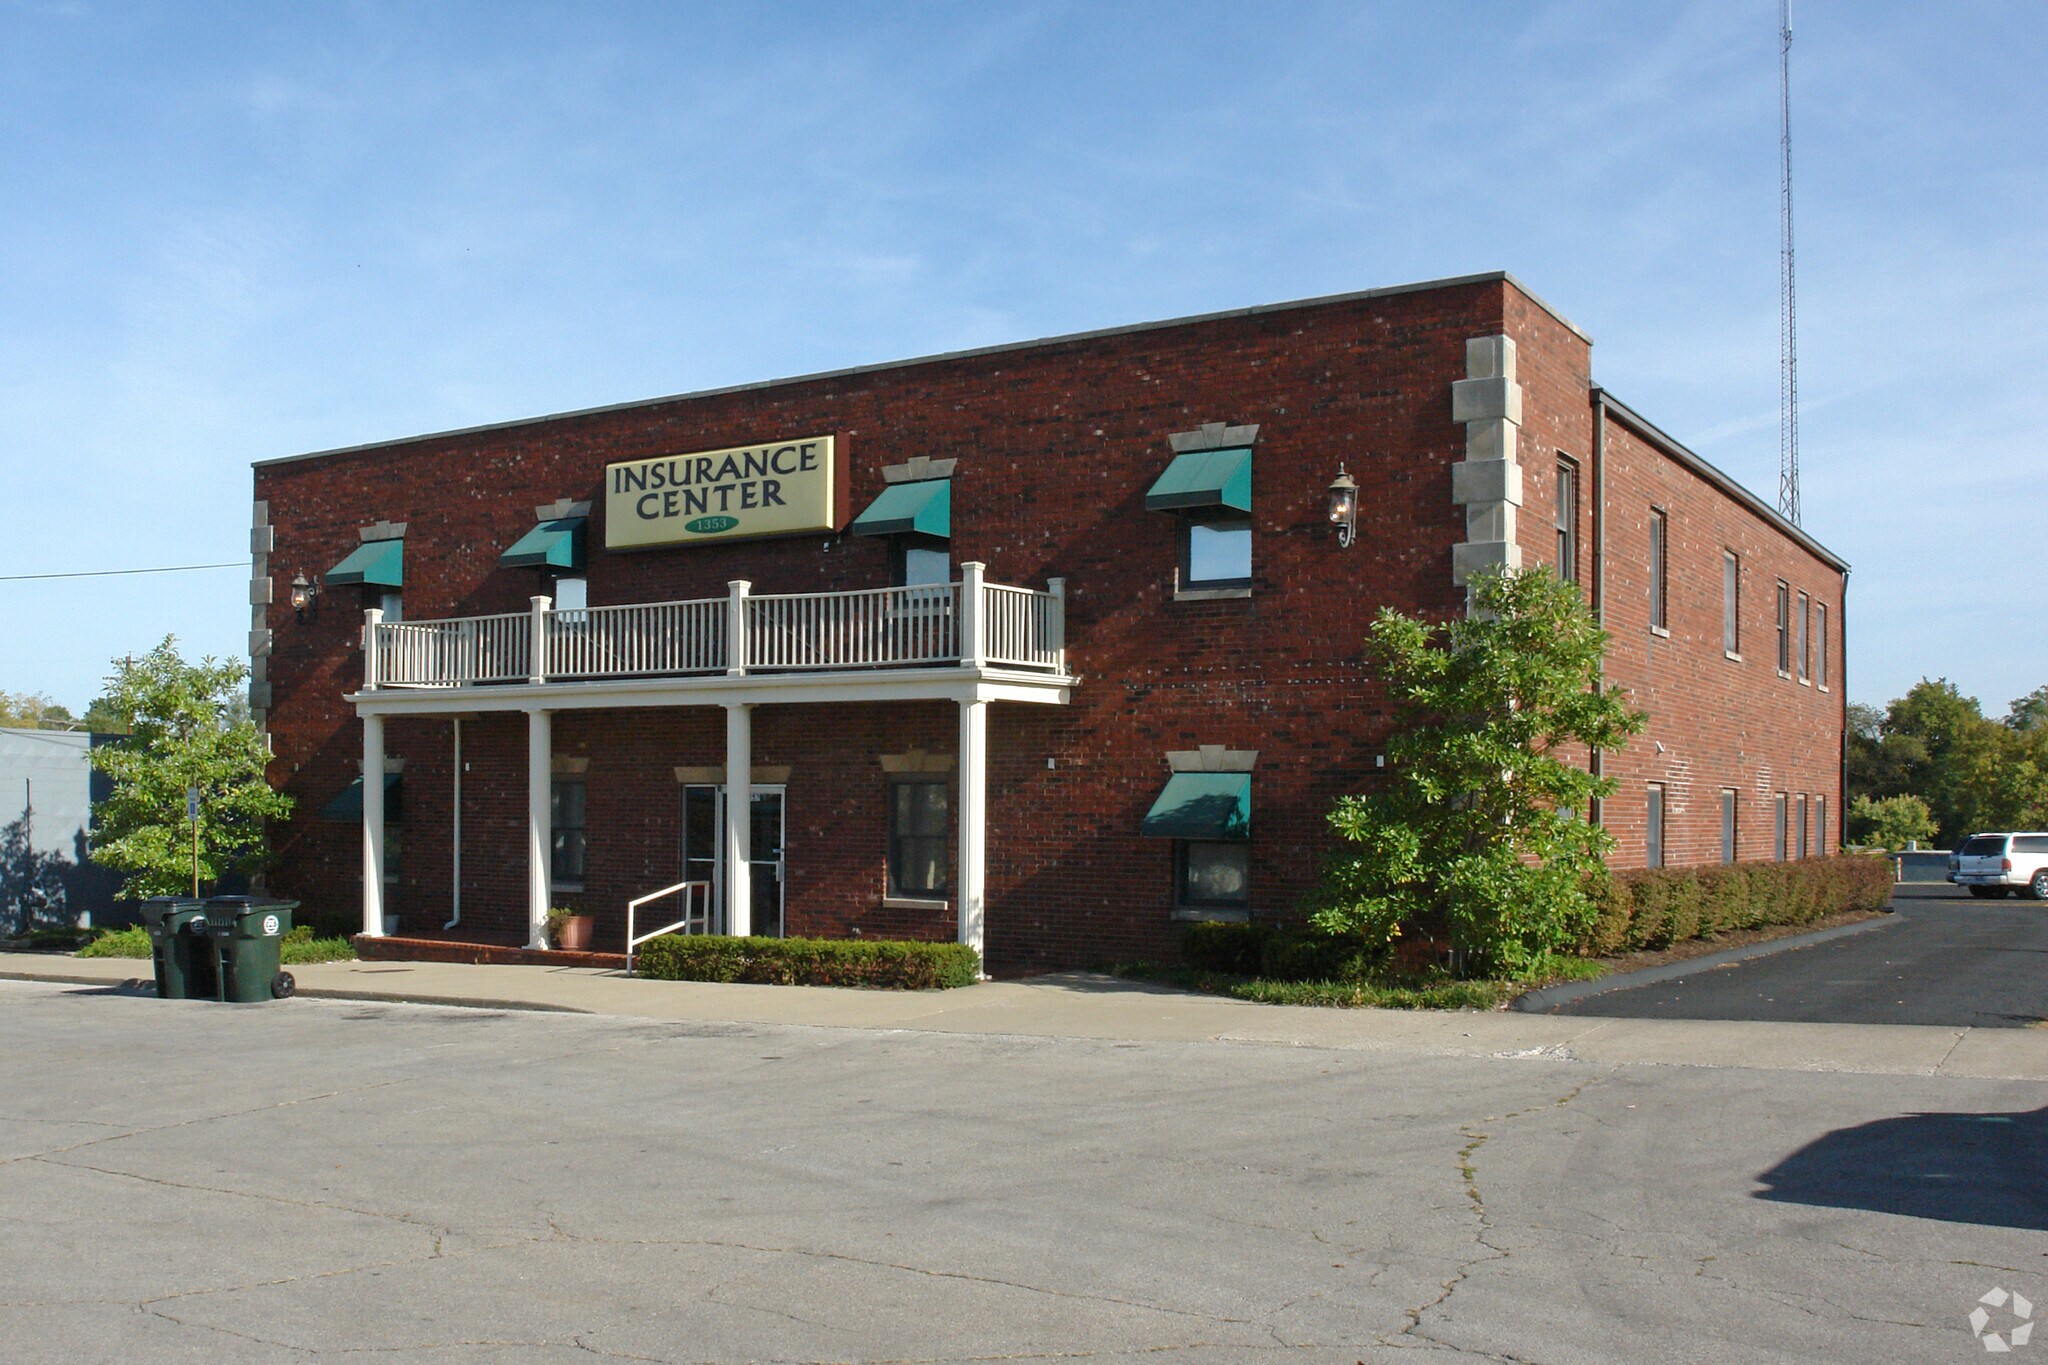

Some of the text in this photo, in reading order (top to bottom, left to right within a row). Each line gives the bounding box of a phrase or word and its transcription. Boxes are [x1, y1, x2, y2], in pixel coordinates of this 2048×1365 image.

[615, 443, 818, 493] INSURANCE
[636, 480, 786, 519] CENTER
[697, 517, 727, 530] 1353
